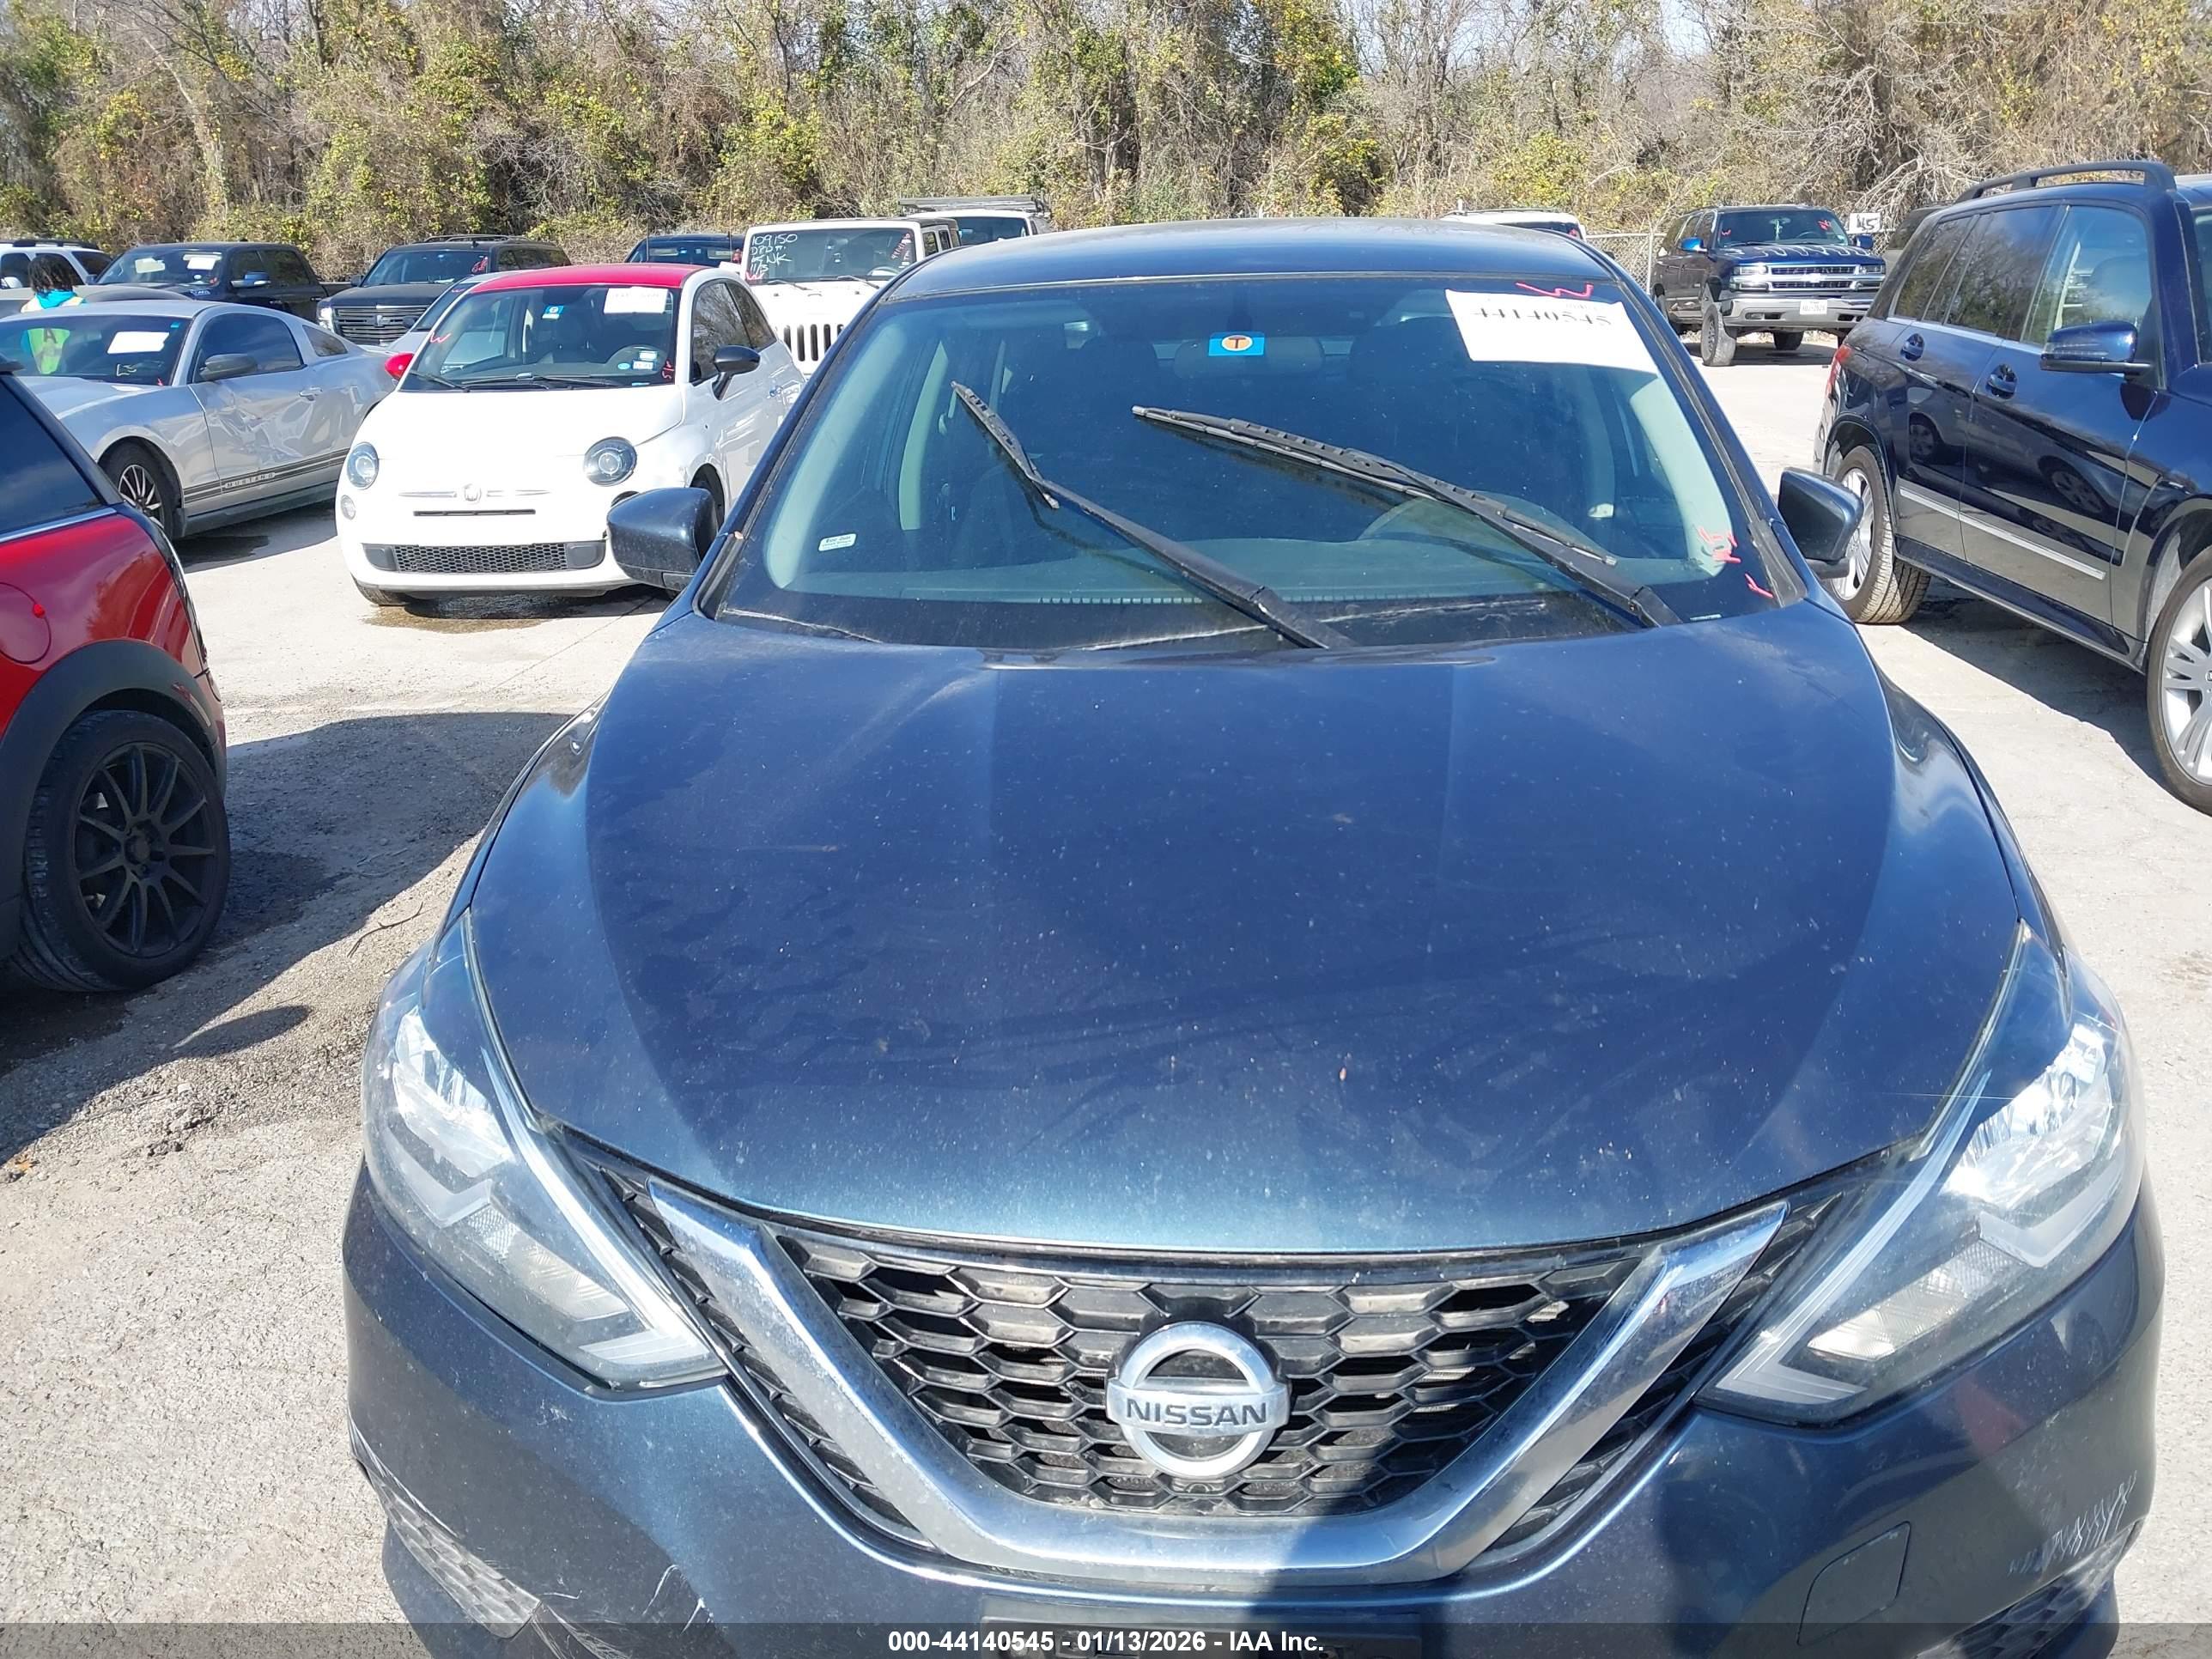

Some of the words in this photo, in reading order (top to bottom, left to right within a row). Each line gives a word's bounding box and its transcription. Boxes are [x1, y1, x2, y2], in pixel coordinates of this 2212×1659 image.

[751, 234, 798, 246] 109150
[1473, 307, 1612, 325] 44140545
[1229, 337, 1247, 349] T
[1127, 1399, 1267, 1426] NISSAN
